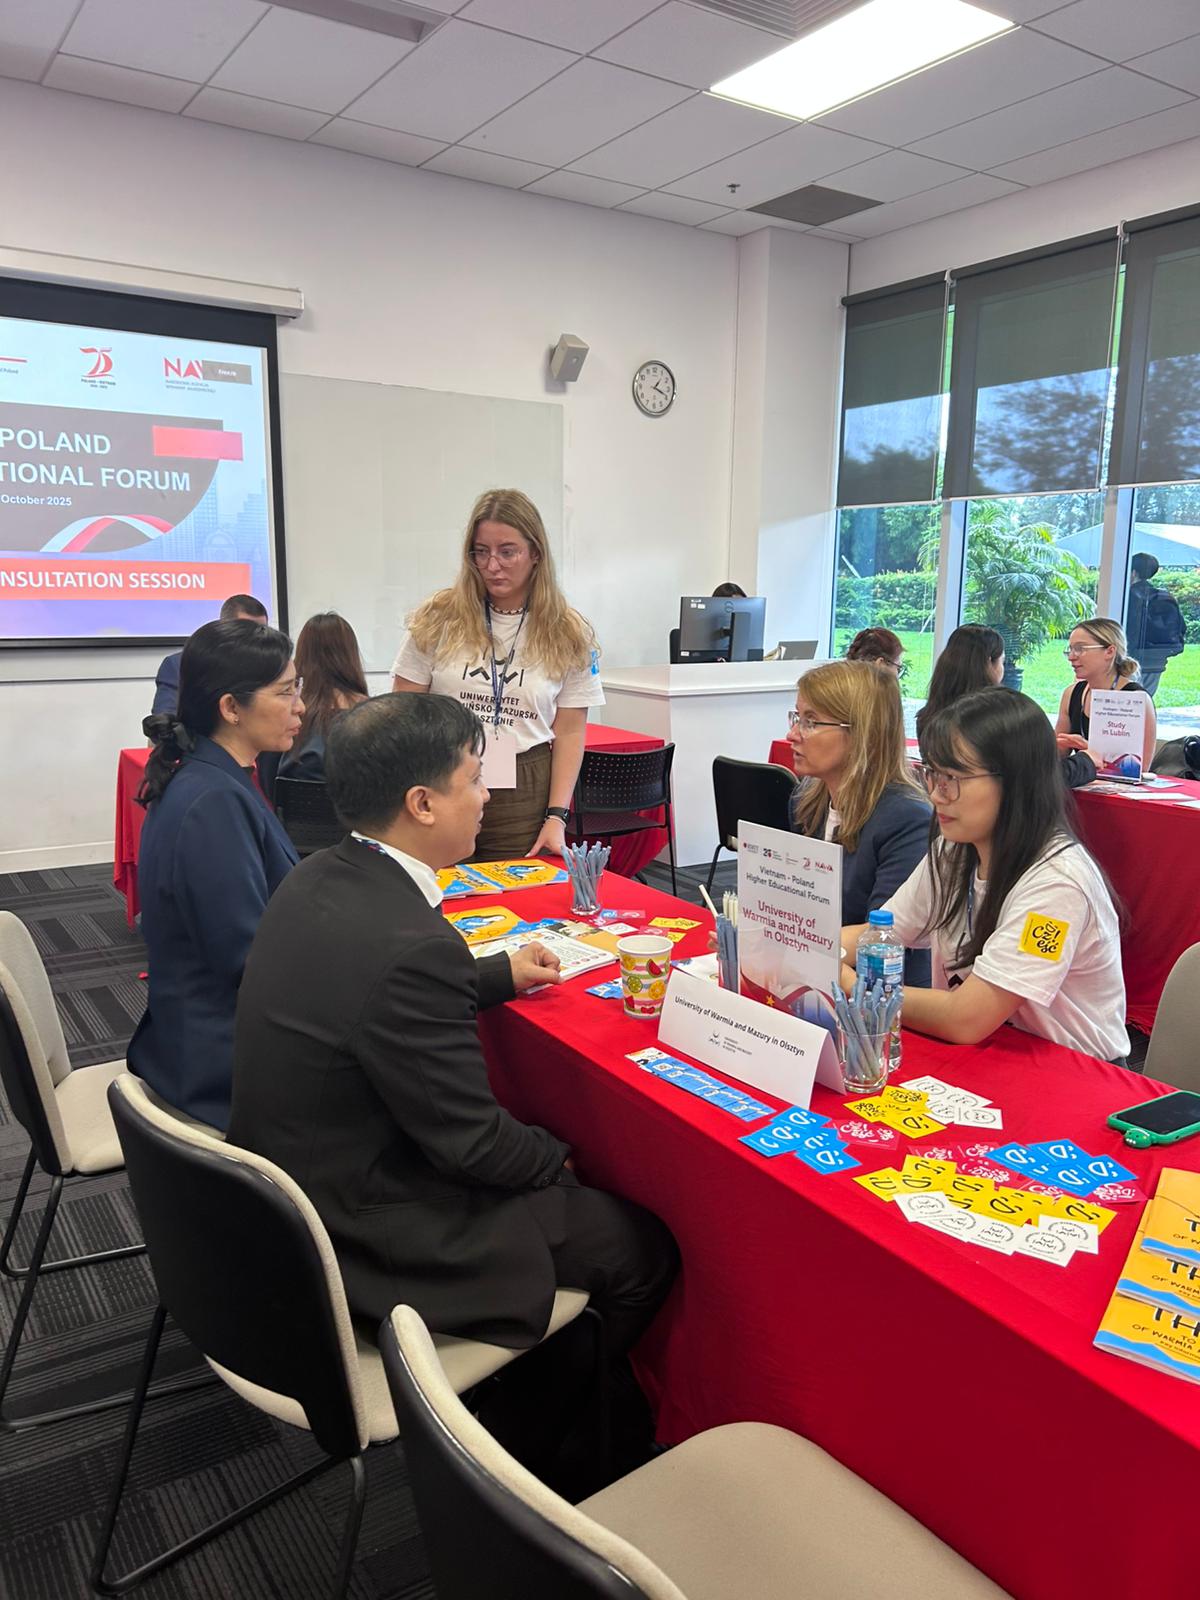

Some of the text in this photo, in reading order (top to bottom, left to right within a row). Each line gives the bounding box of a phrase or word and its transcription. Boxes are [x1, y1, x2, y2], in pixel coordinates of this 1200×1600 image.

[0, 427, 111, 454] POLAND
[100, 467, 190, 491] FORUM
[0, 494, 72, 506] October 2025
[129, 572, 205, 589] SESSION
[460, 691, 520, 706] UNIWERYTET
[1107, 721, 1126, 729] Study
[1110, 729, 1130, 737] Lublin
[746, 872, 831, 905] Higher Educational Forum
[759, 865, 786, 881] Vietnam
[791, 875, 815, 889] Poland
[758, 900, 816, 928] University of
[742, 907, 834, 950] Warmia and Mazury
[763, 927, 809, 952] in Olsztyn
[674, 995, 805, 1057] University of Warmia and Mazury in Olsztyn
[1152, 1330, 1192, 1350] WARMIA
[1181, 1335, 1197, 1344] TO
